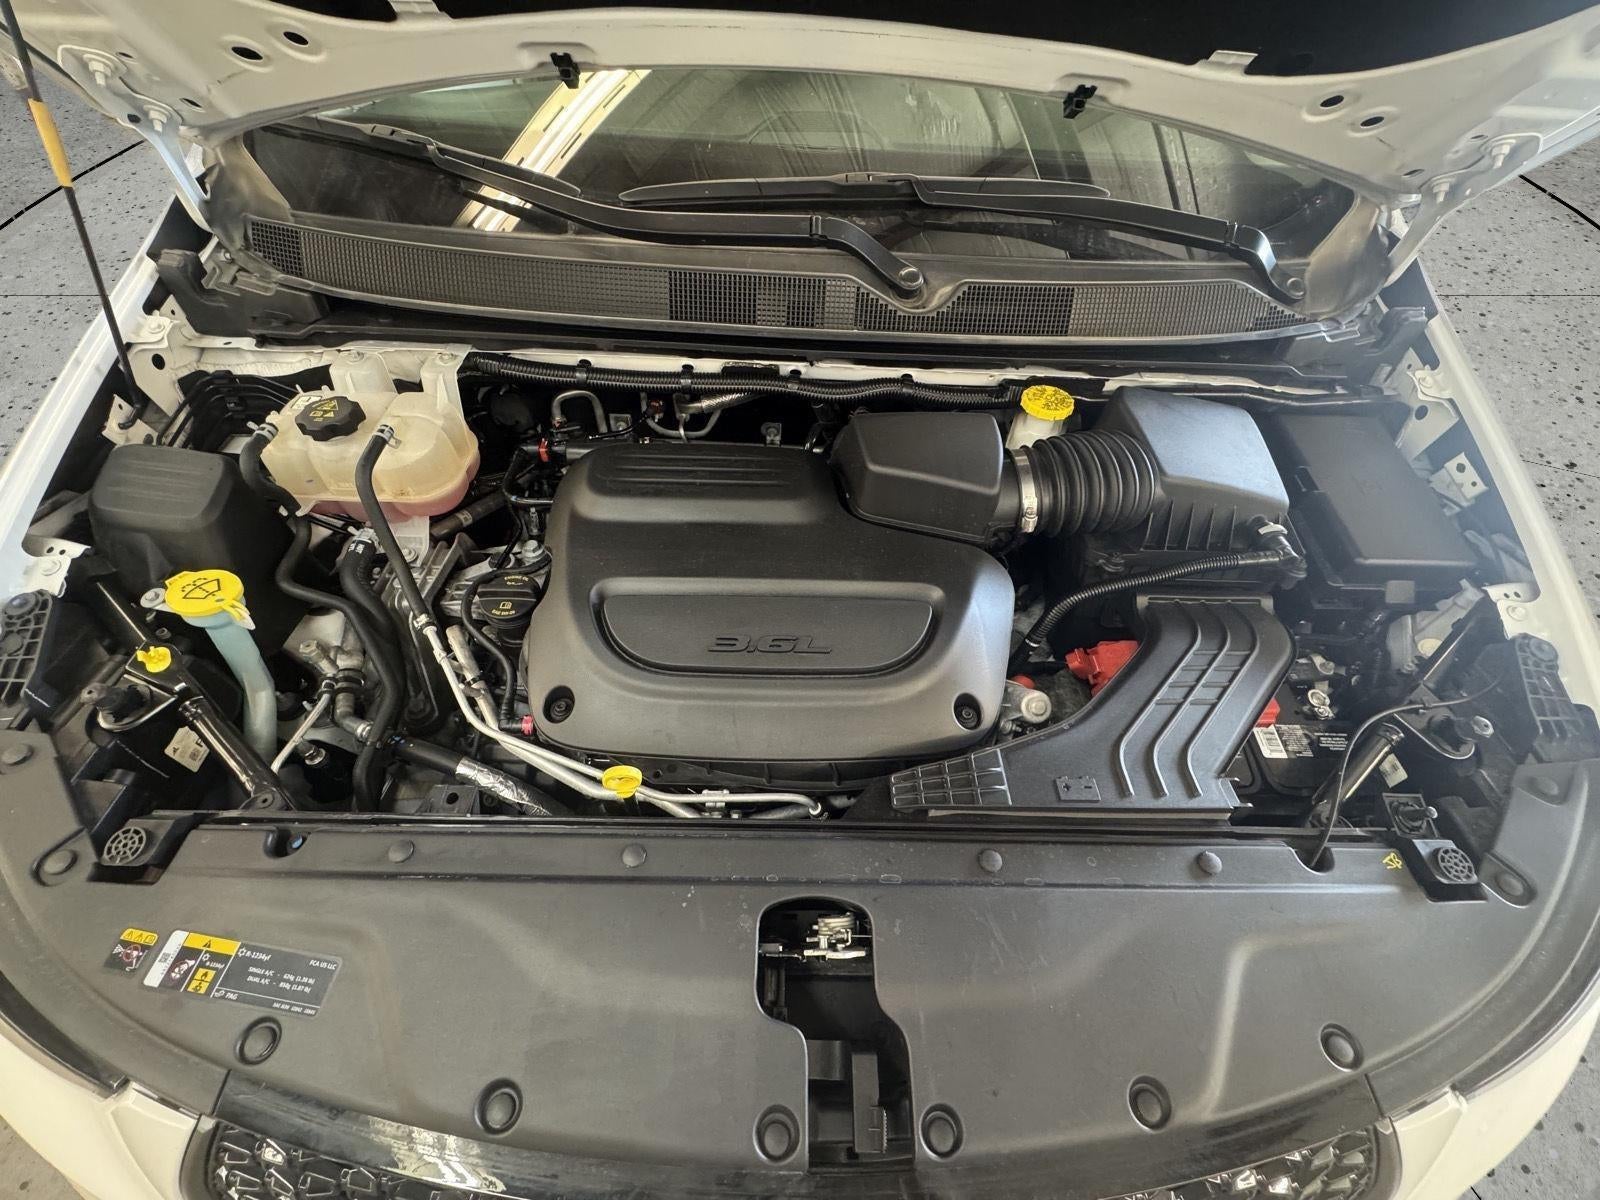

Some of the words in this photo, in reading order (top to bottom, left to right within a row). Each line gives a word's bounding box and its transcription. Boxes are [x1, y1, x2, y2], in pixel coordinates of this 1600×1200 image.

[705, 634, 832, 654] 3.6L
[245, 950, 272, 962] R-1234yf
[309, 959, 320, 967] FCA
[320, 961, 328, 969] US
[327, 962, 338, 970] LLC
[247, 966, 265, 975] SINGLE
[264, 969, 275, 977] A/C
[260, 977, 271, 985] A/C
[225, 991, 239, 1000] PAG
